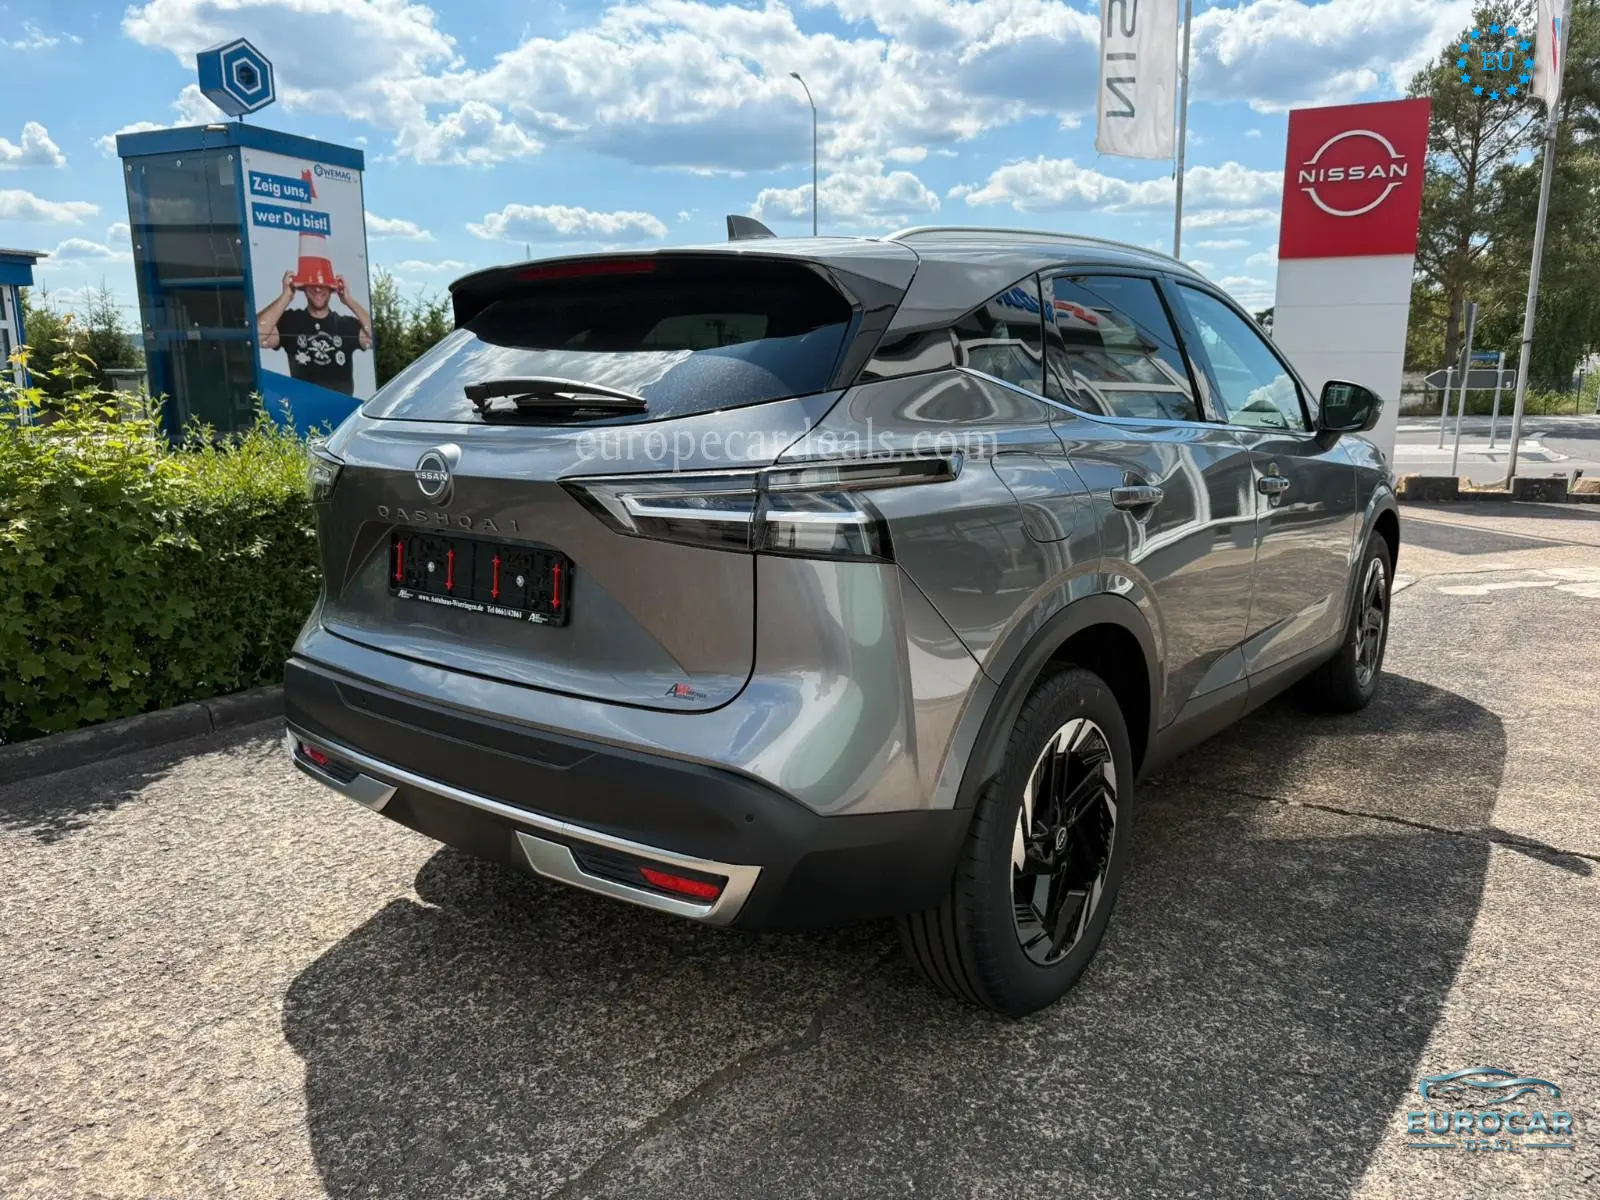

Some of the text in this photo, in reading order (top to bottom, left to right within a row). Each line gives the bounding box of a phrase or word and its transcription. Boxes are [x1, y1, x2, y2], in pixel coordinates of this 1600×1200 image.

[323, 168, 351, 180] WEMAG
[1298, 163, 1408, 184] NISSAN
[252, 176, 308, 200] Zeig uns,
[255, 211, 328, 230] wer Du bist!
[414, 471, 449, 481] NISSAN
[377, 505, 520, 532] QASHQAI
